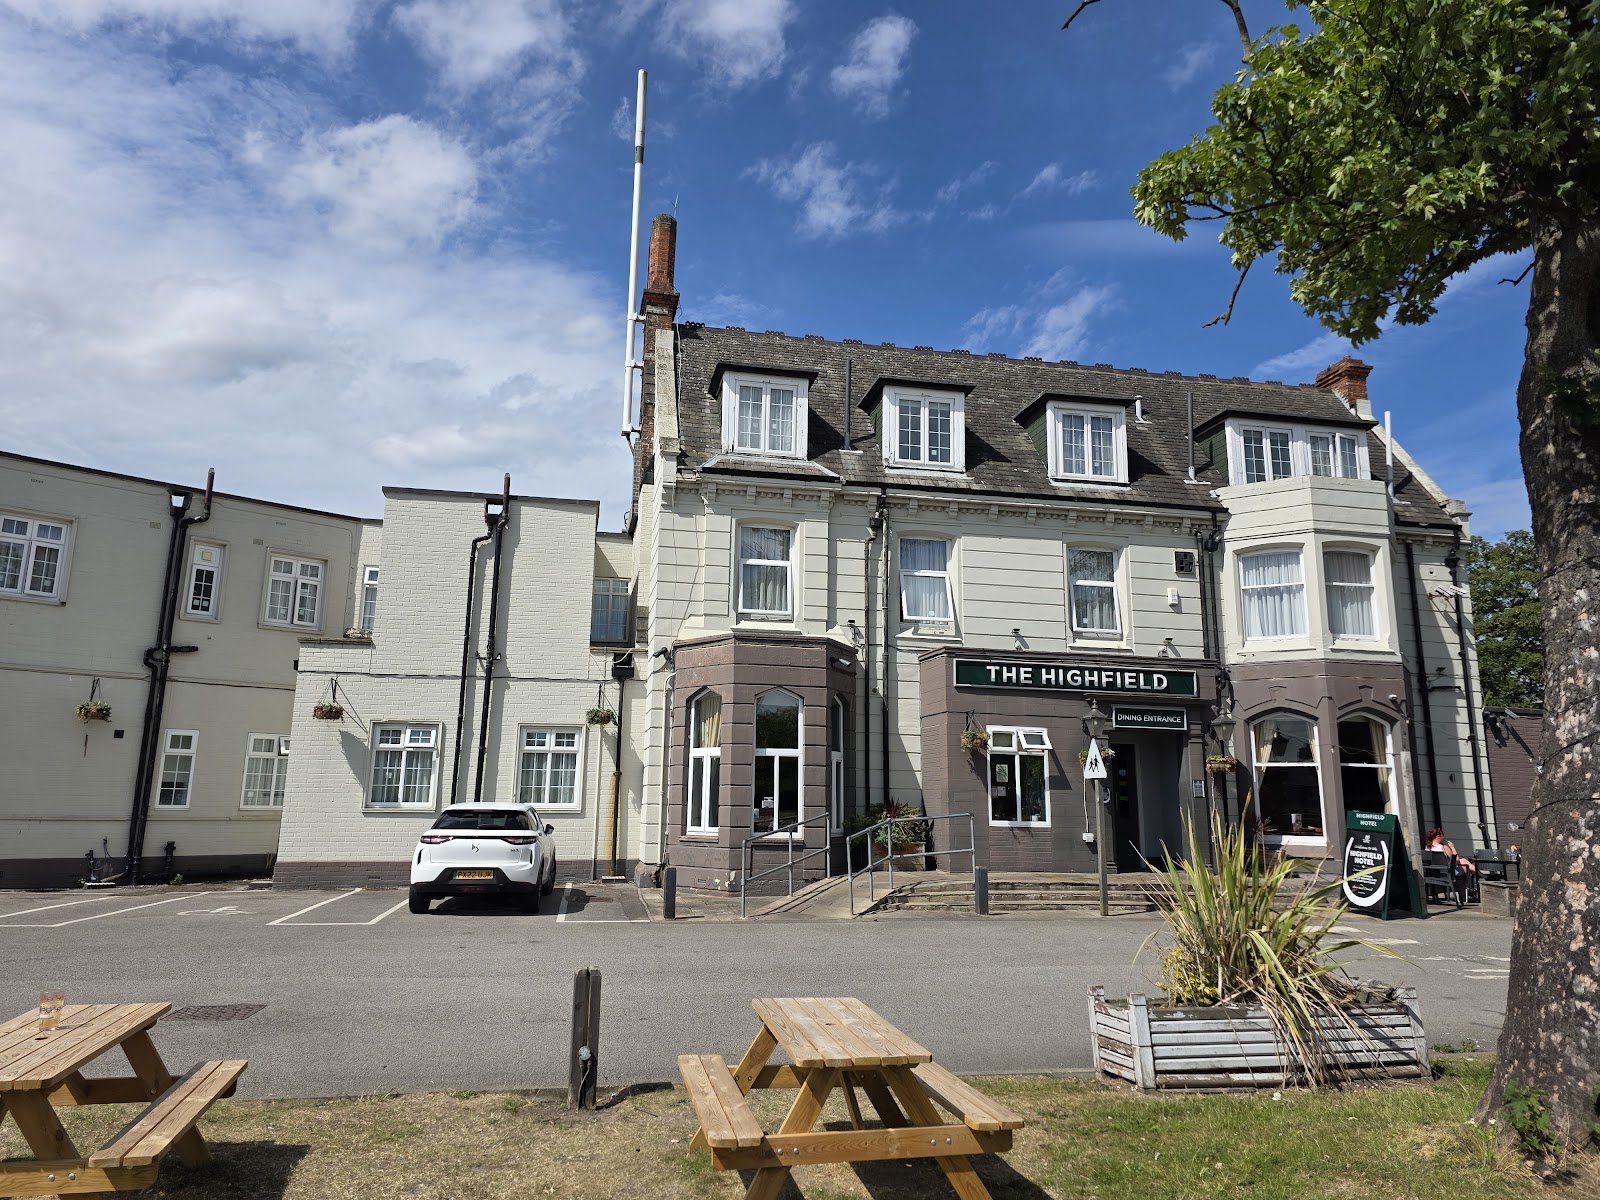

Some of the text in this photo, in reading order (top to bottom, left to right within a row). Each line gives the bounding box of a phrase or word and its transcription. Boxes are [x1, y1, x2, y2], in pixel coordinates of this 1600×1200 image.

[986, 665, 1168, 690] THE HIGHFIELD
[1117, 713, 1182, 723] DINING ENTRANCE
[1350, 850, 1382, 860] HIGHFIELD
[1354, 857, 1375, 866] HOTEL
